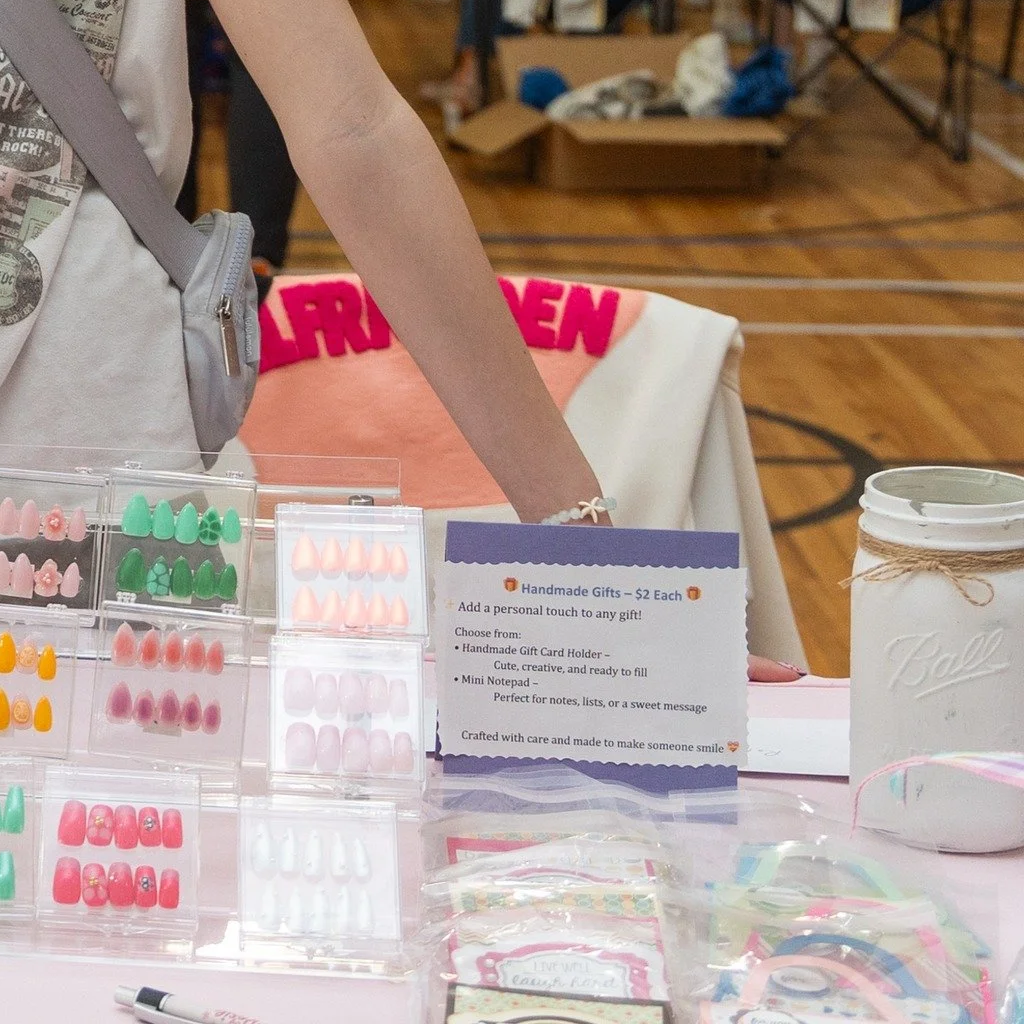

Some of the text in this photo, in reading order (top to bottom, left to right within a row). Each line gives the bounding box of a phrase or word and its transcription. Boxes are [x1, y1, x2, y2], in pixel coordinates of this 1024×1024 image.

[8, 125, 53, 144] THERE
[1, 140, 43, 157] ROCK!
[19, 246, 41, 280] BLACK
[244, 316, 253, 357] lululemon
[521, 583, 589, 597] Handmade
[591, 586, 621, 599] Gifts
[635, 587, 650, 601] $2
[653, 589, 683, 602] Each
[457, 601, 642, 623] Add a personal touch to any gift!
[454, 626, 522, 640] Choose from:
[462, 642, 518, 655] Handmade
[519, 645, 539, 656] Gift
[540, 646, 565, 658] Card
[567, 648, 603, 660] Holder
[493, 660, 648, 679] Cute, creative, and ready to fill
[884, 628, 1008, 696] Ball
[461, 674, 485, 685] Mini
[487, 675, 530, 689] Notepad
[493, 691, 708, 715] Perfect for notes, lists, or a sweet message
[461, 729, 725, 754] Crafted with care and made to make someone smile
